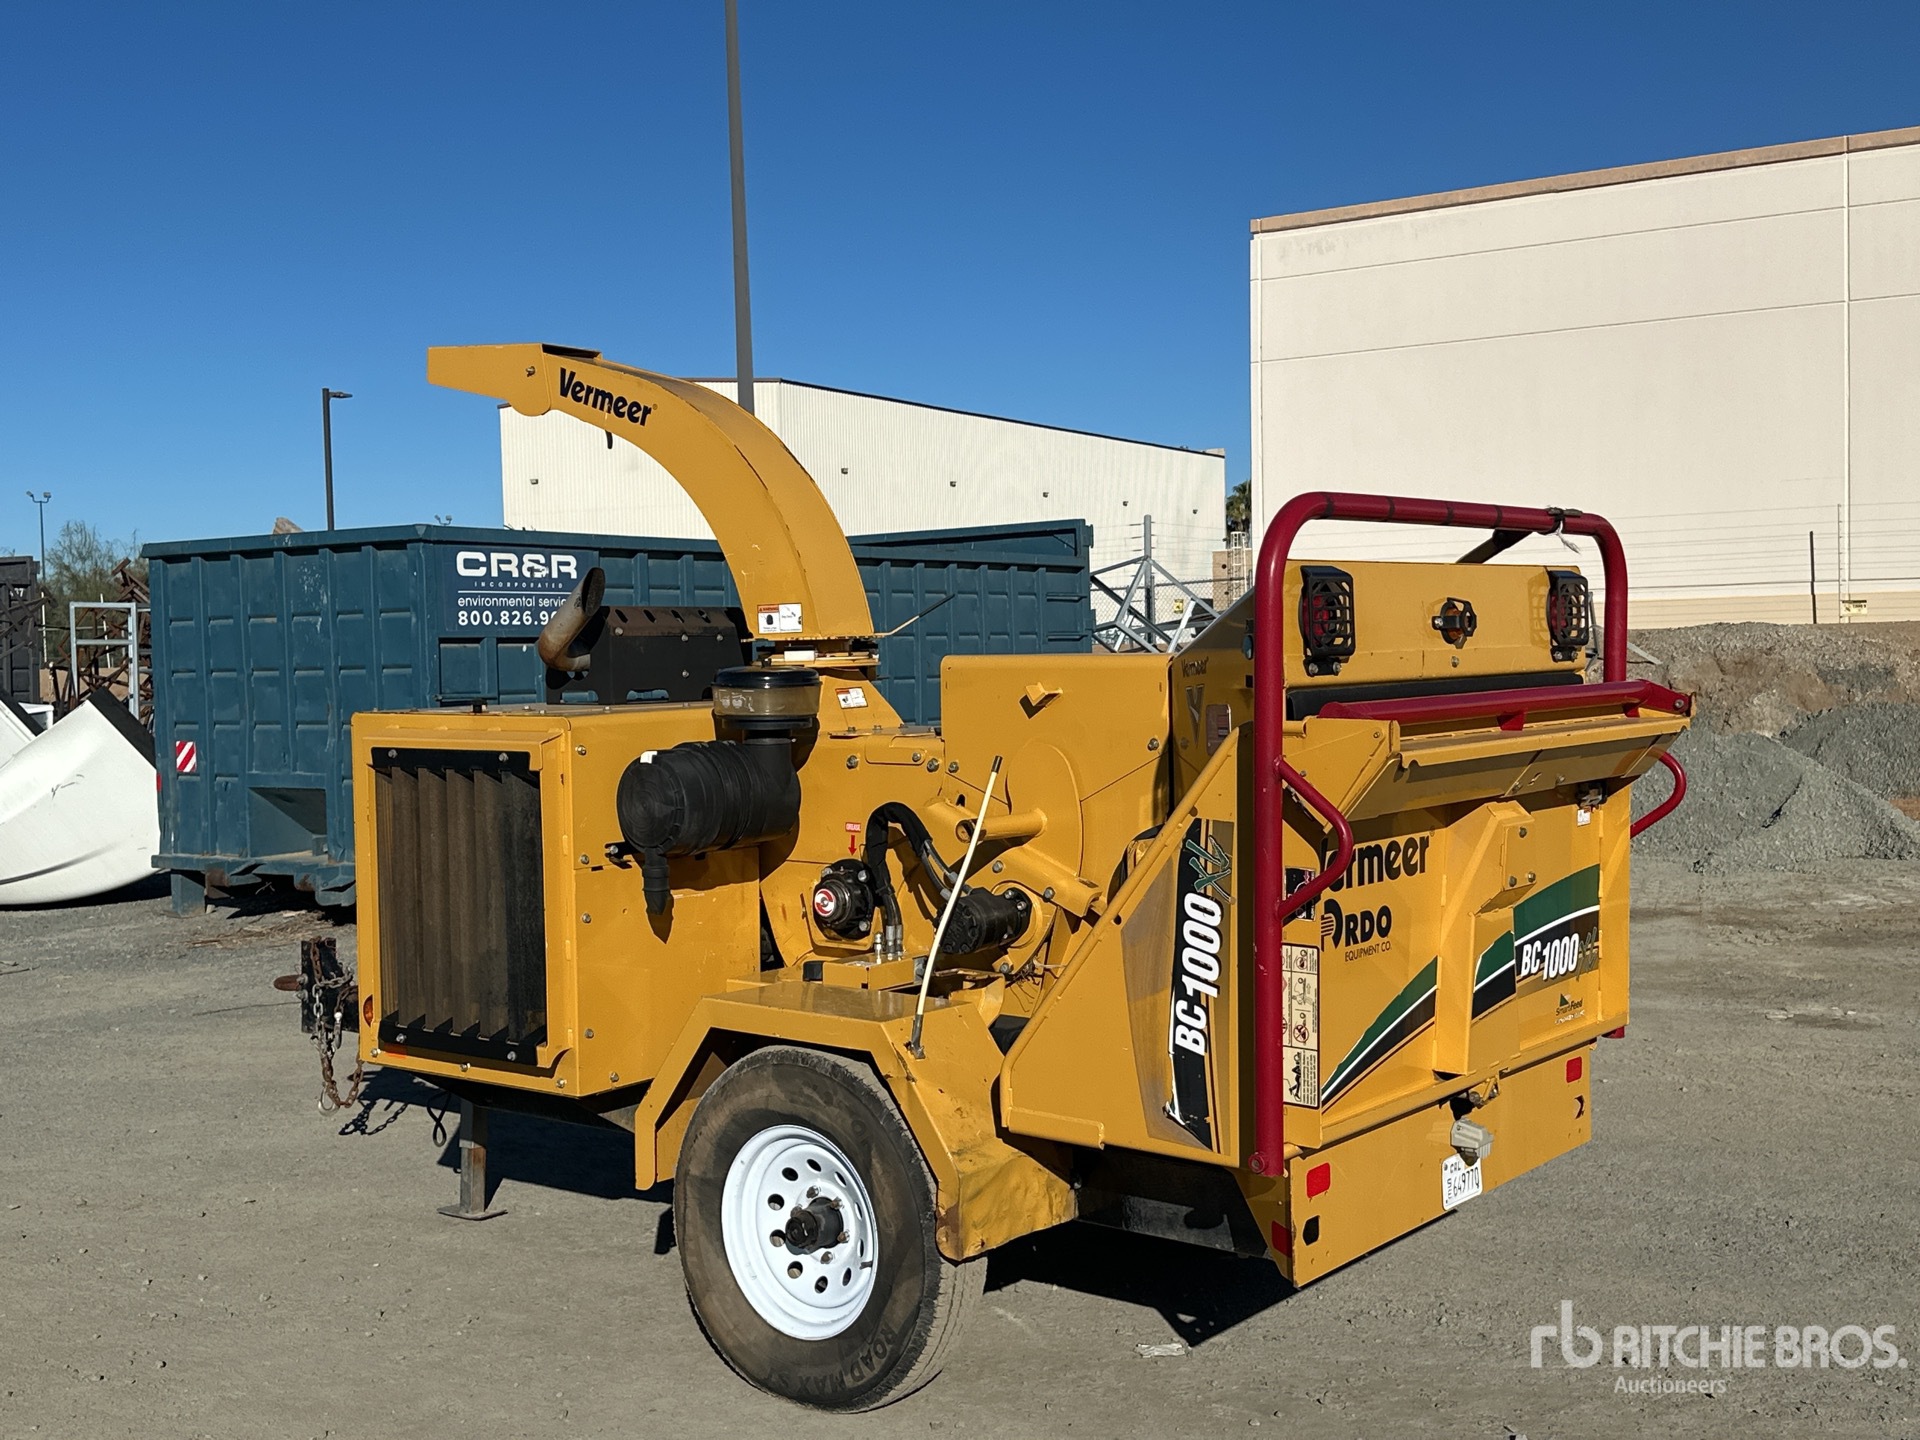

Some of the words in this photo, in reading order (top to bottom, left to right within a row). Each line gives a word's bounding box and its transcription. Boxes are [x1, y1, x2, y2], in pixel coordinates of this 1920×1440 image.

[559, 366, 653, 427] Vermeer
[456, 551, 578, 579] CR&R
[457, 595, 536, 608] environmental
[474, 581, 563, 589] INCORPORATED
[1181, 891, 1223, 999] 1000
[1344, 944, 1380, 962] EQUIPMENT
[1520, 940, 1542, 977] BC
[1542, 932, 1580, 981] 1000
[1175, 999, 1208, 1057] BC
[850, 1322, 898, 1384] ROAD
[798, 1371, 847, 1396] MAX
